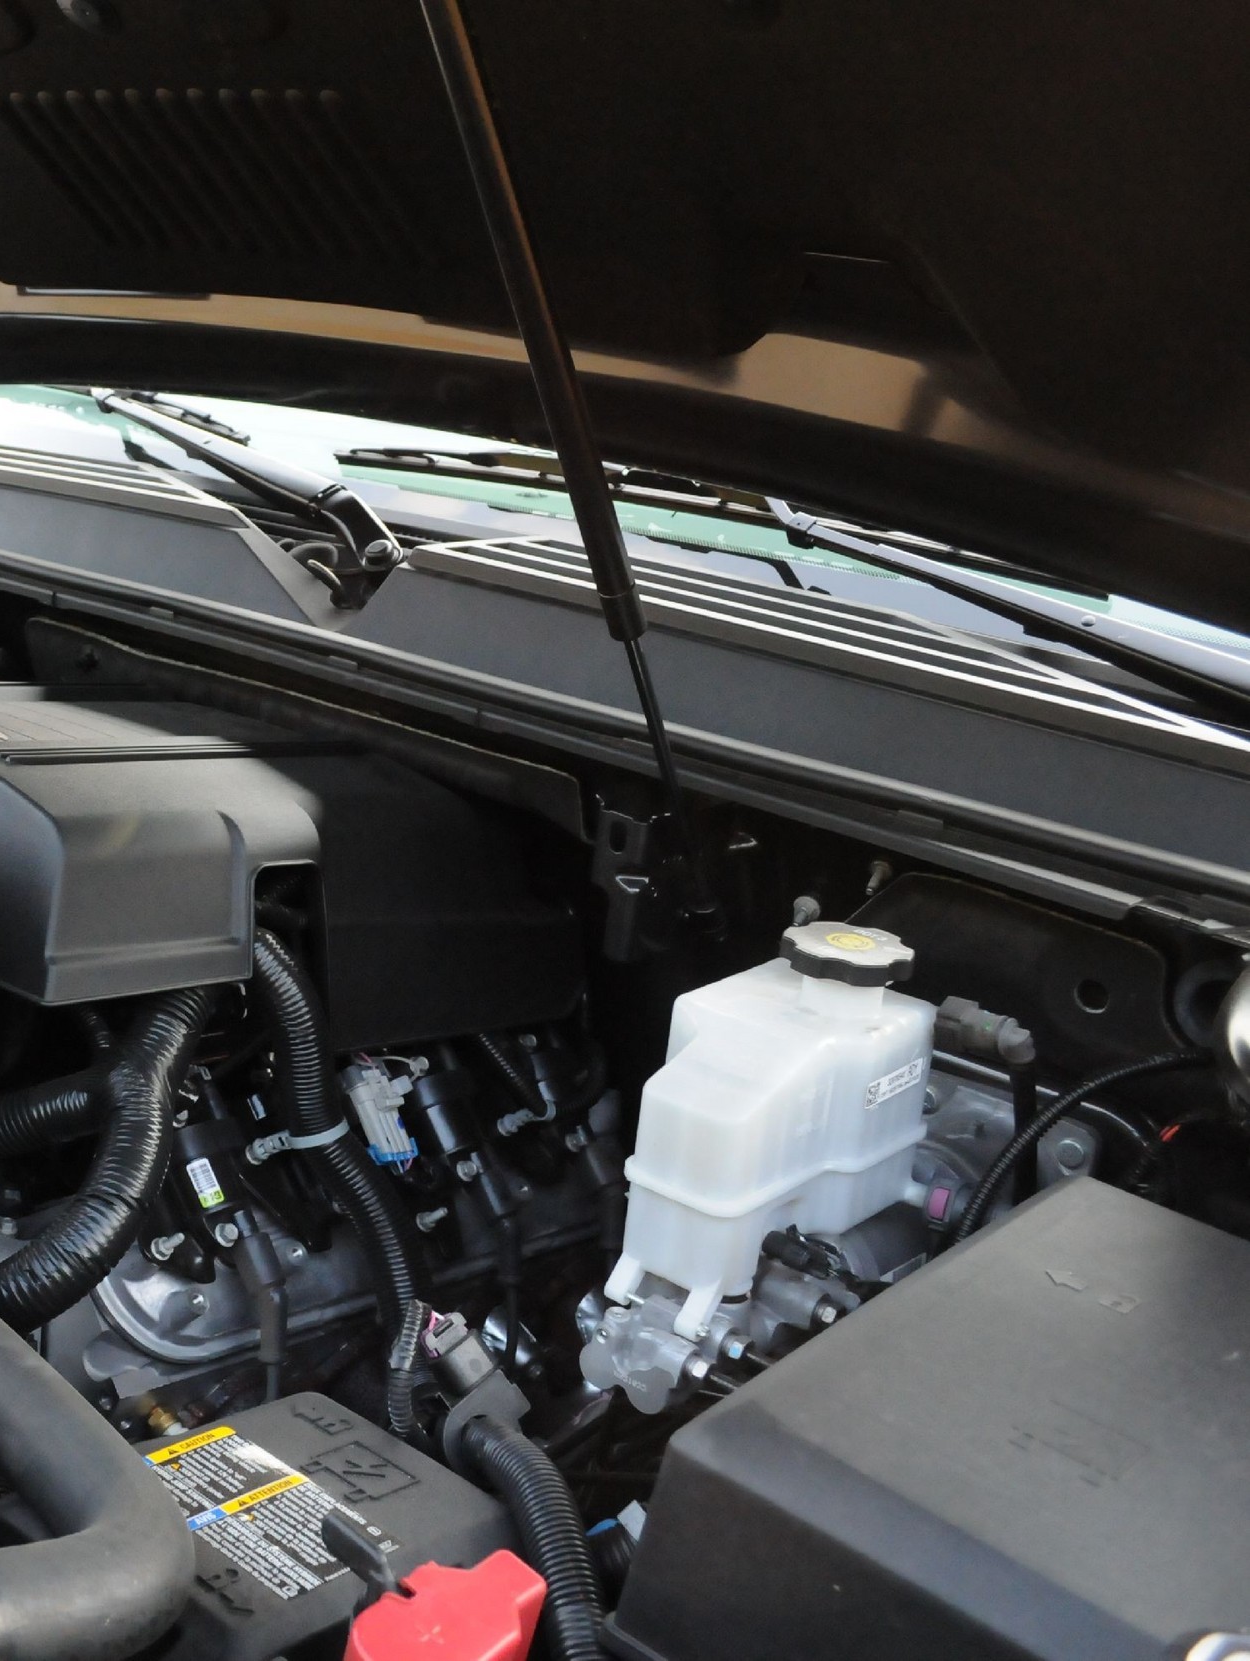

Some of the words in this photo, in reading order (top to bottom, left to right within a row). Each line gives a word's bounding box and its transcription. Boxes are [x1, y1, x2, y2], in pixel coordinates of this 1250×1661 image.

[179, 1434, 215, 1449] CAUTION
[249, 1480, 292, 1499] ATTENTION
[195, 1512, 216, 1524] AVIS
